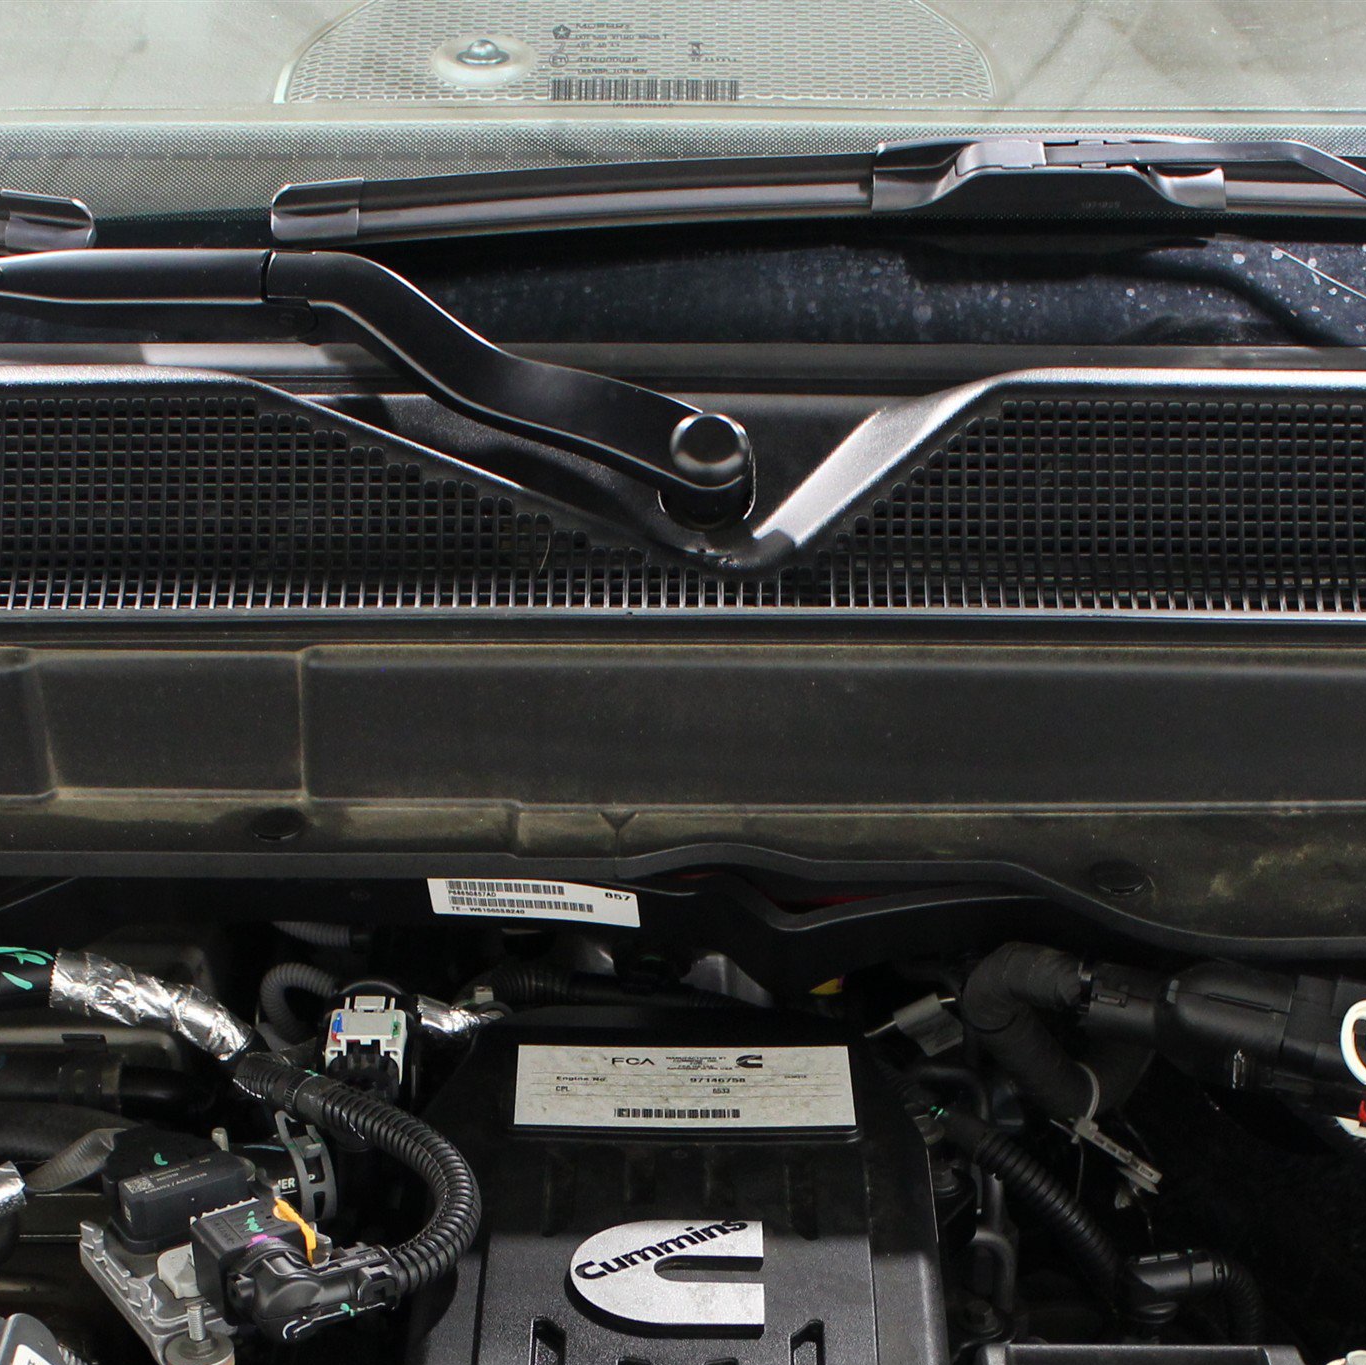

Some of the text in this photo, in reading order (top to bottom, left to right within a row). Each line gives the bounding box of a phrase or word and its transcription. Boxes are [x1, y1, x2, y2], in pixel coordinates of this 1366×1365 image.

[604, 891, 631, 902] 857
[611, 1057, 655, 1066] FCA
[575, 1218, 748, 1281] Cummins
